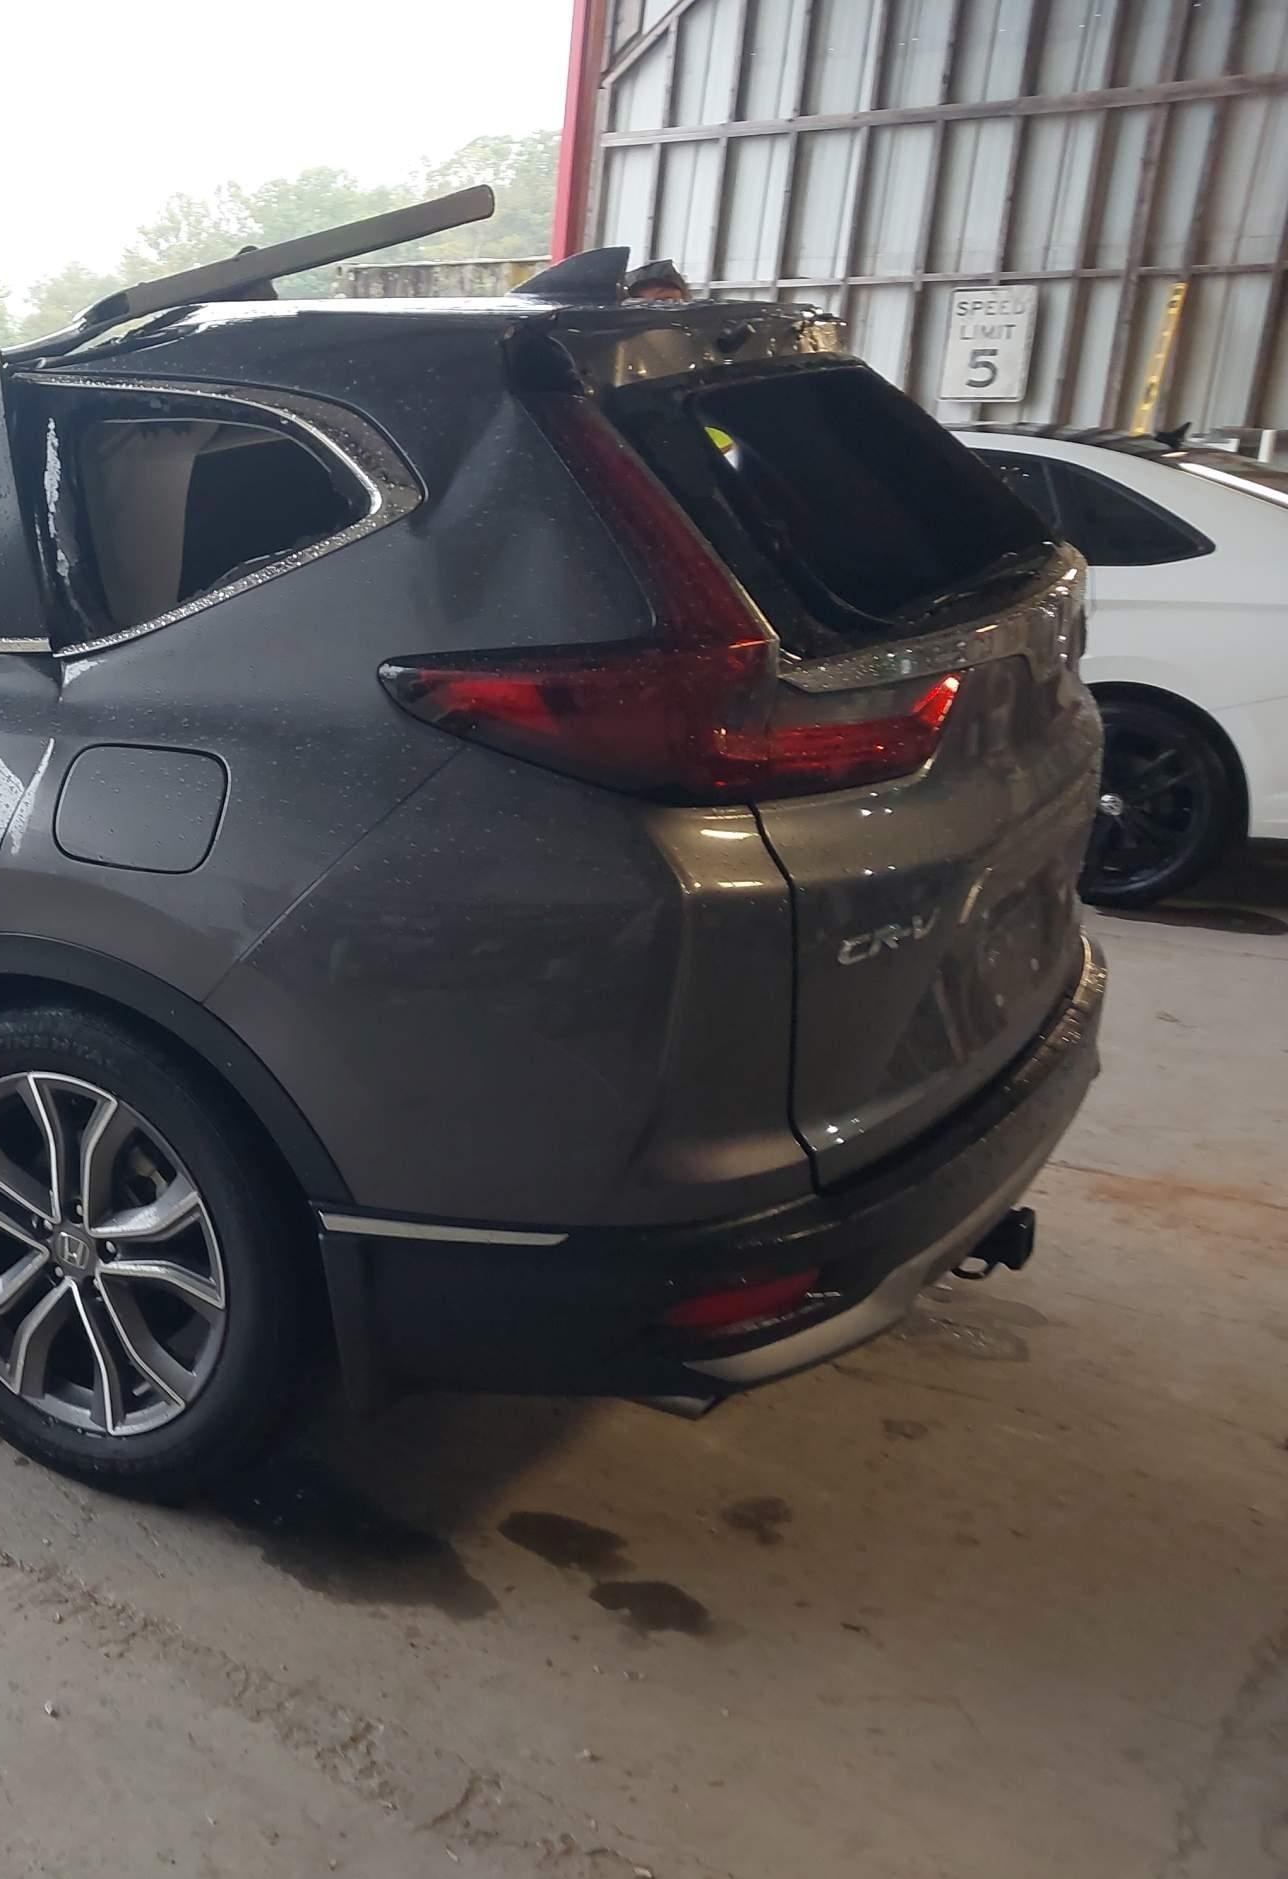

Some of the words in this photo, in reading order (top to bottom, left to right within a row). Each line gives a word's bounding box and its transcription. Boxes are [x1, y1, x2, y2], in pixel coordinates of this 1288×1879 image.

[956, 301, 1024, 316] SPEED
[960, 324, 1017, 340] LIMIT
[966, 349, 999, 388] 5
[838, 907, 940, 966] CR-V
